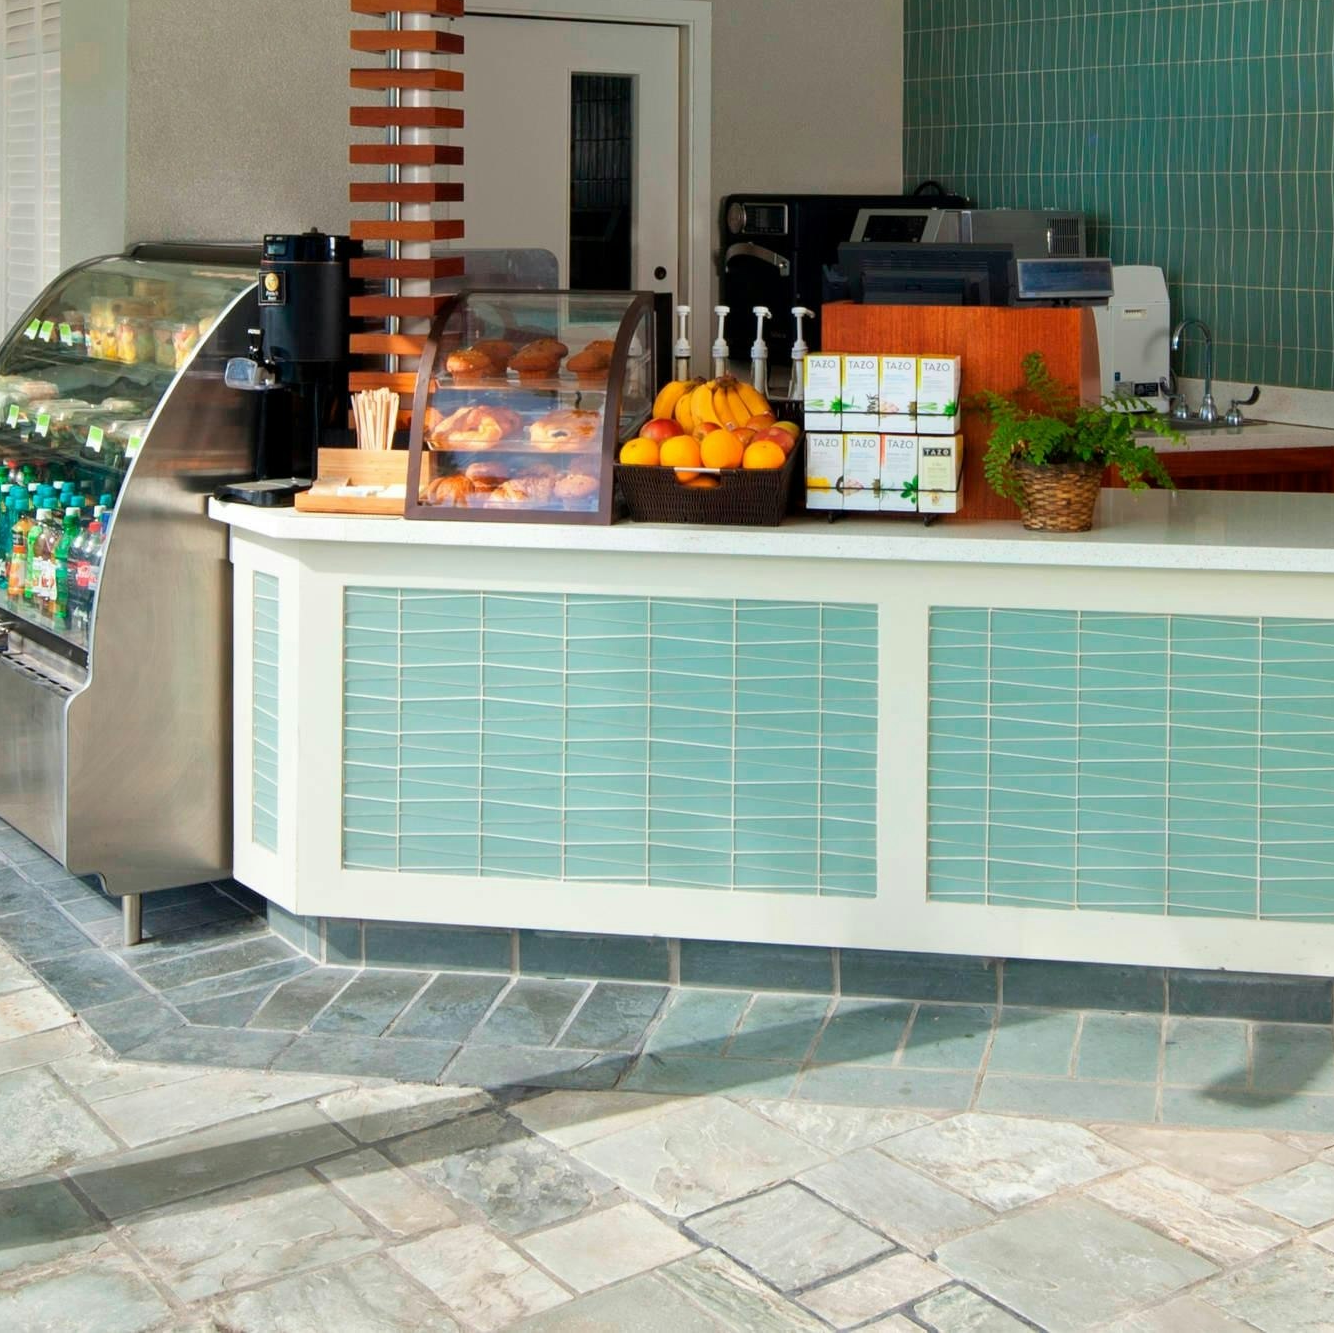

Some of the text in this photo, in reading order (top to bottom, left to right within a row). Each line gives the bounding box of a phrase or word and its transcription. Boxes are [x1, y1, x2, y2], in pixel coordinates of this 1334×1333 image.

[810, 360, 835, 368] TAZO
[849, 361, 874, 369] TAZO
[886, 361, 911, 370] TAZO
[924, 363, 950, 371] TAZO
[813, 439, 838, 447] TAZO
[850, 439, 875, 448] TAZO
[888, 440, 913, 448] TAZO
